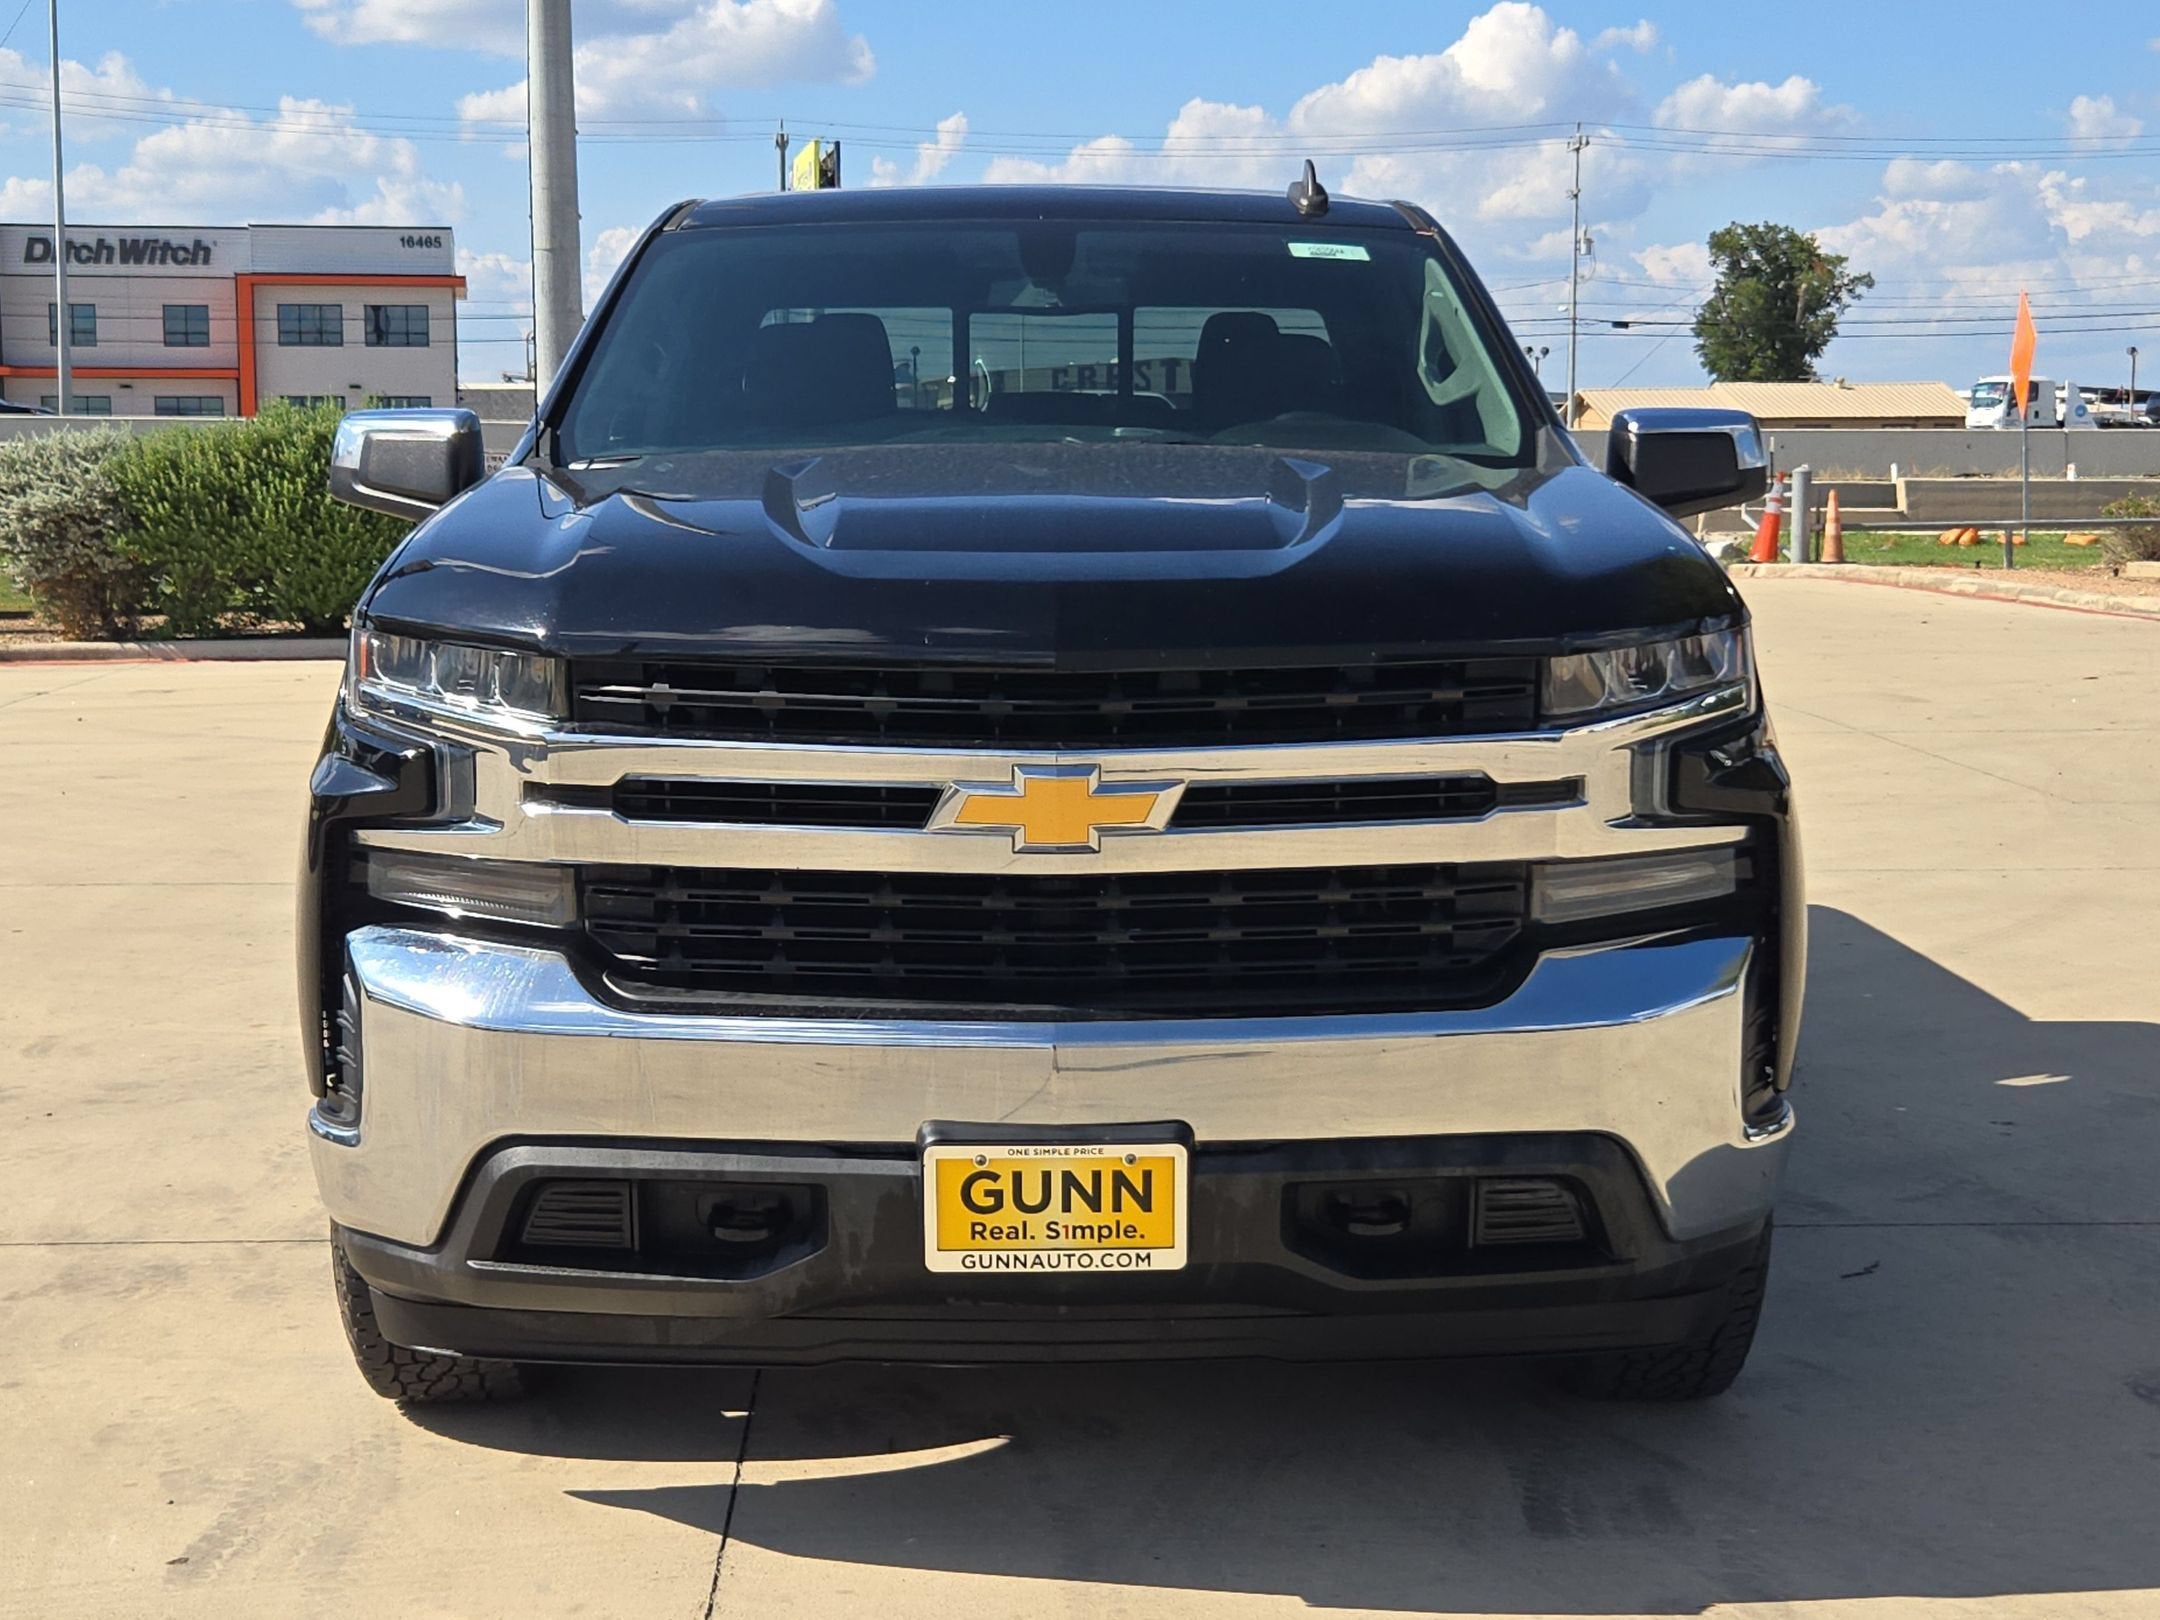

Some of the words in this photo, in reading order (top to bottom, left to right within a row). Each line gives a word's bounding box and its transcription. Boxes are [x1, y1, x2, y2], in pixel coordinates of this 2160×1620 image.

[400, 235, 442, 249] 16465
[119, 238, 212, 265] Witch
[1007, 1148, 1030, 1156] ONE
[1033, 1147, 1070, 1156] SIMPLE
[1073, 1147, 1104, 1155] PRICE
[960, 1169, 1152, 1215] GUNN
[970, 1221, 1035, 1240] Real.
[961, 1253, 1151, 1270] GUNNAUTO.COM
